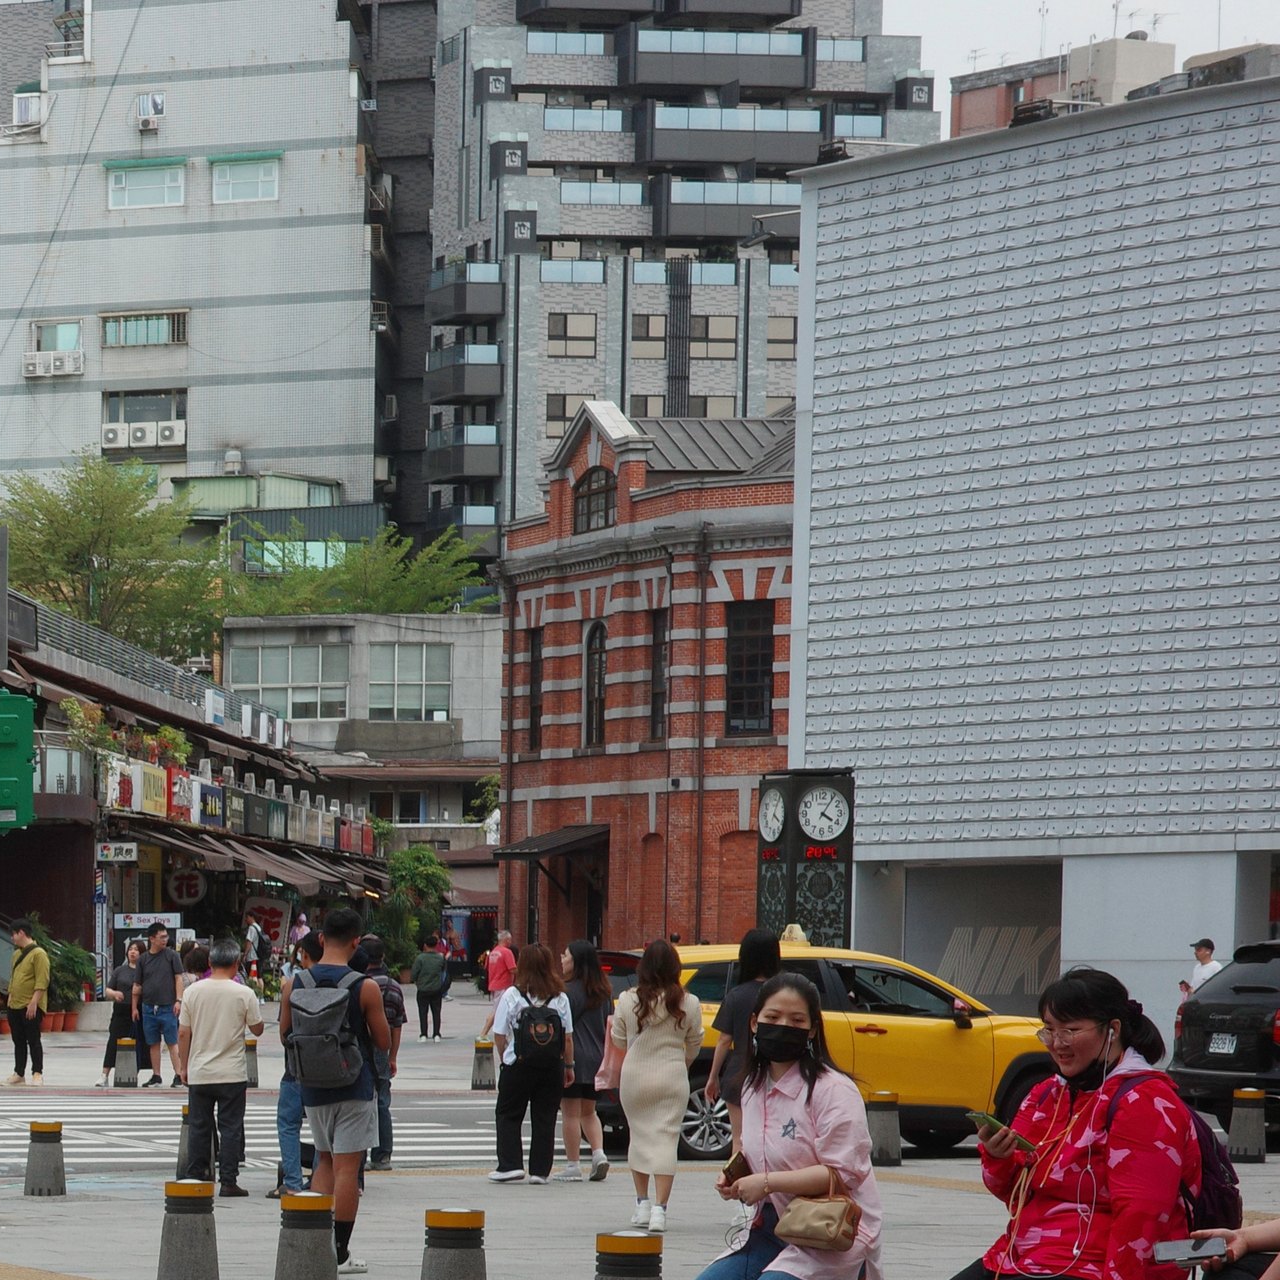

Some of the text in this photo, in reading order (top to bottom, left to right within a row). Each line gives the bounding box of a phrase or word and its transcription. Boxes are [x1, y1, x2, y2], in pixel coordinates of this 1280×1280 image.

[174, 873, 199, 898] 花
[137, 915, 151, 924] Sex
[936, 926, 1062, 995] NIK
